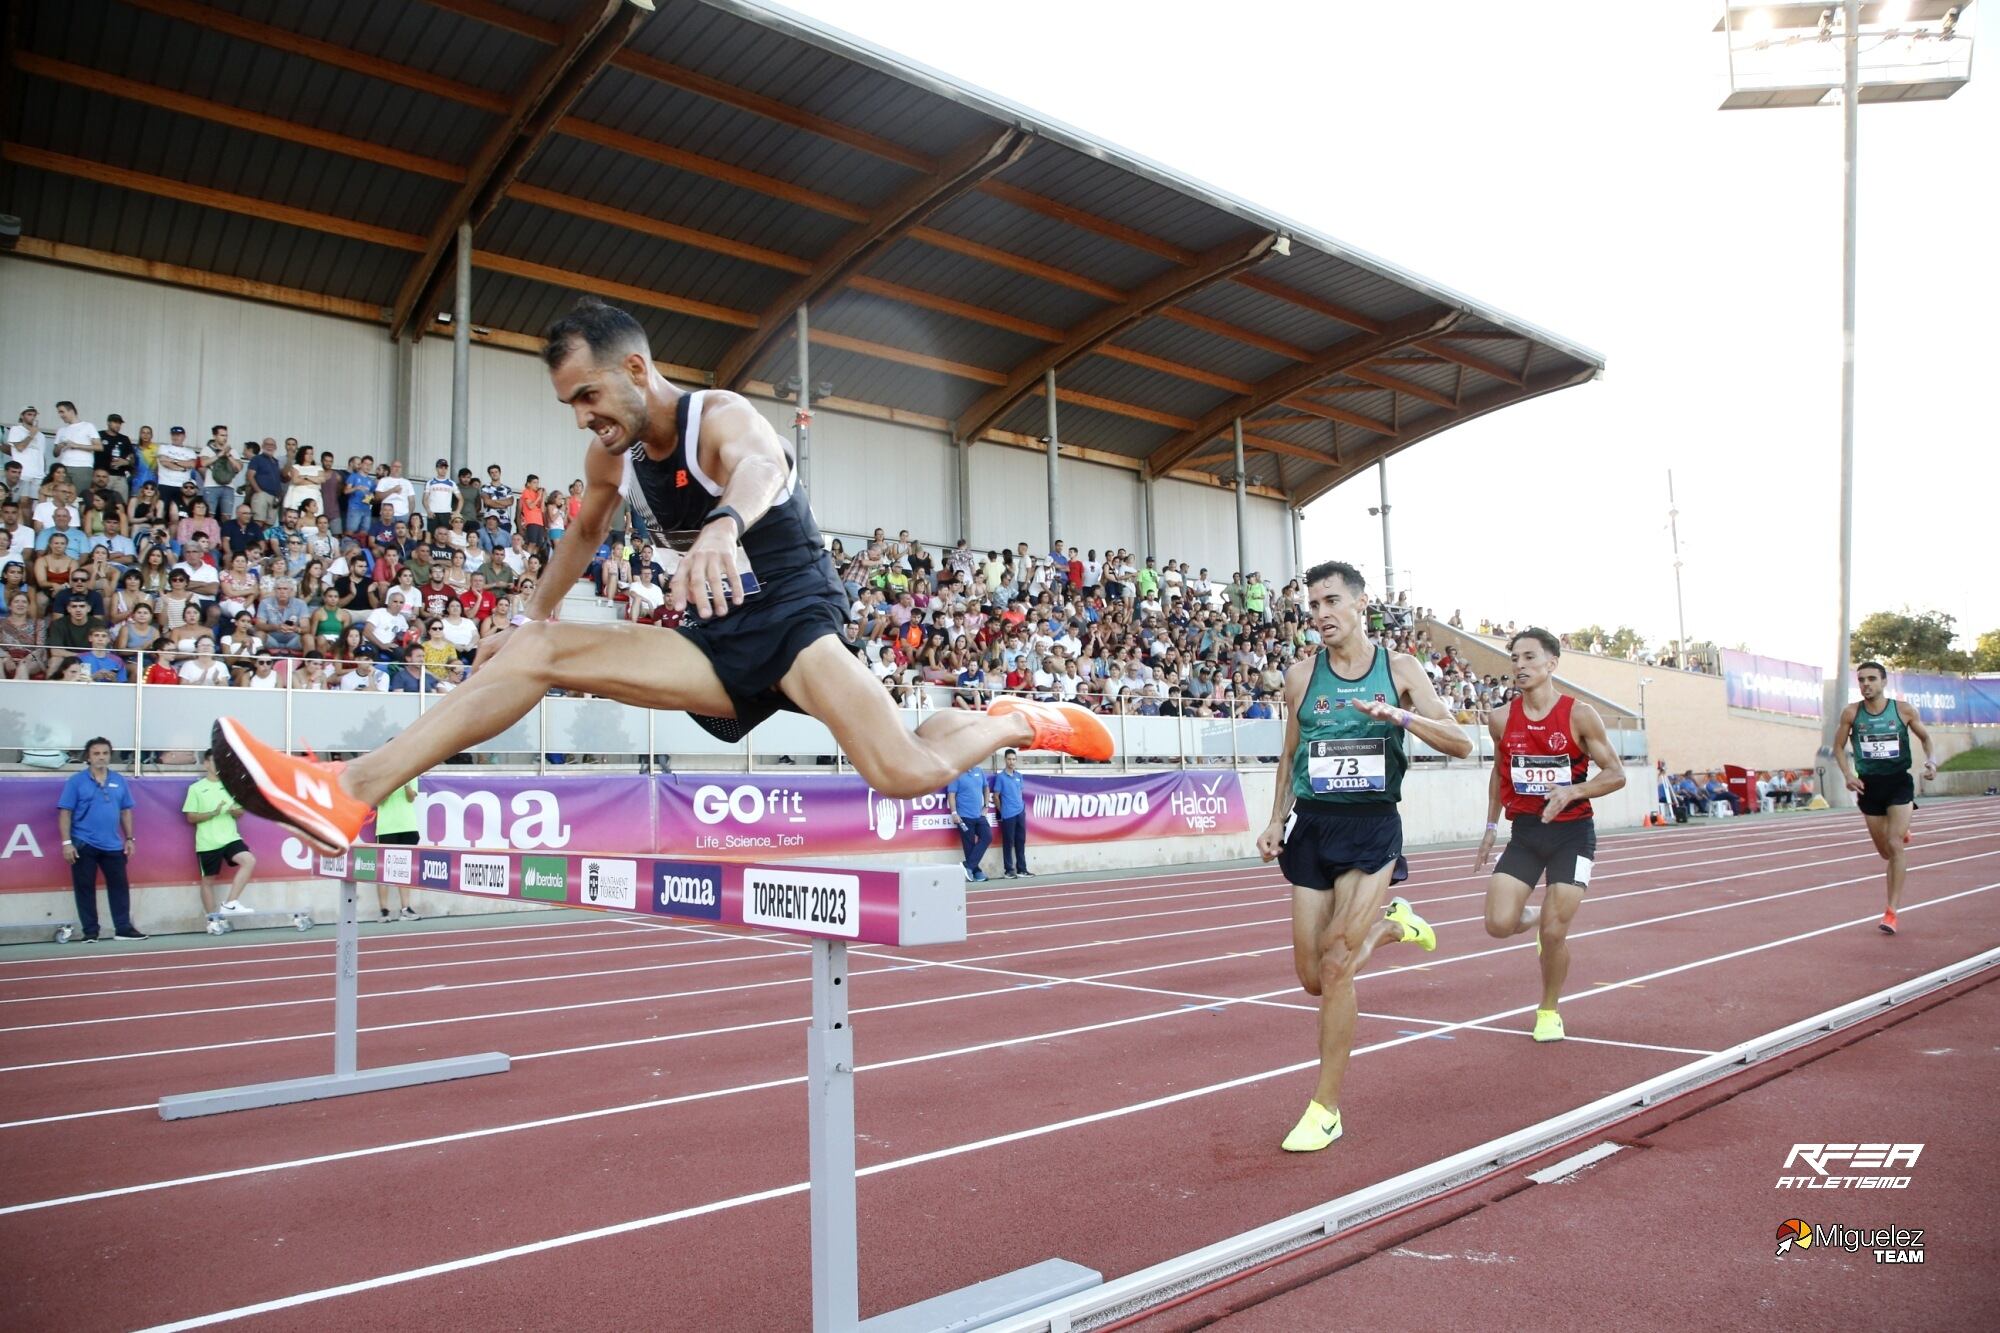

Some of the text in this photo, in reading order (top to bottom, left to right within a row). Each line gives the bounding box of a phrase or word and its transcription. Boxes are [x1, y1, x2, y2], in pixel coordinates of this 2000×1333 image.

[1933, 694, 1957, 709] 2023
[1872, 742, 1886, 752] 55
[1333, 757, 1360, 776] 73
[1525, 769, 1556, 782] 910
[1054, 792, 1149, 818] MONDO
[922, 818, 938, 826] CON
[696, 834, 804, 850] Life_Science_Tech
[464, 862, 505, 888] TORRENT 2023
[600, 885, 628, 900] TORRENT
[753, 881, 847, 926] TORRENT 2023
